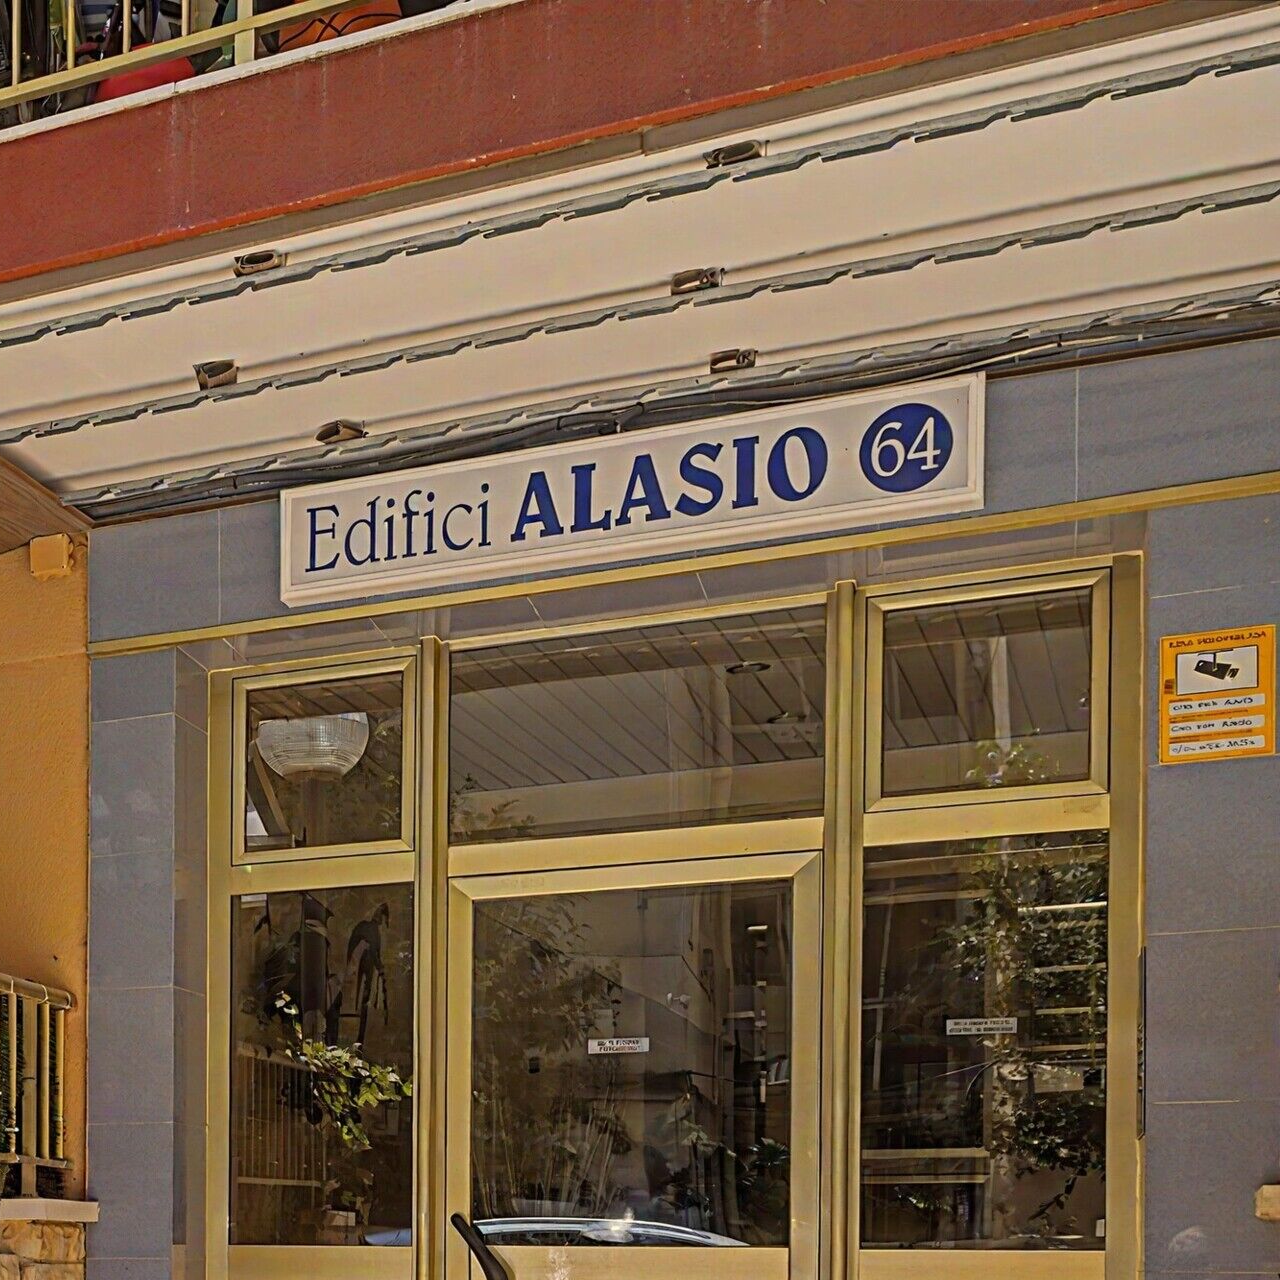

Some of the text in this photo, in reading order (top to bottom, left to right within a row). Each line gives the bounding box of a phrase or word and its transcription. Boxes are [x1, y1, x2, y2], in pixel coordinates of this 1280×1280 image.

[305, 420, 942, 573] Edifici ALASIO 64
